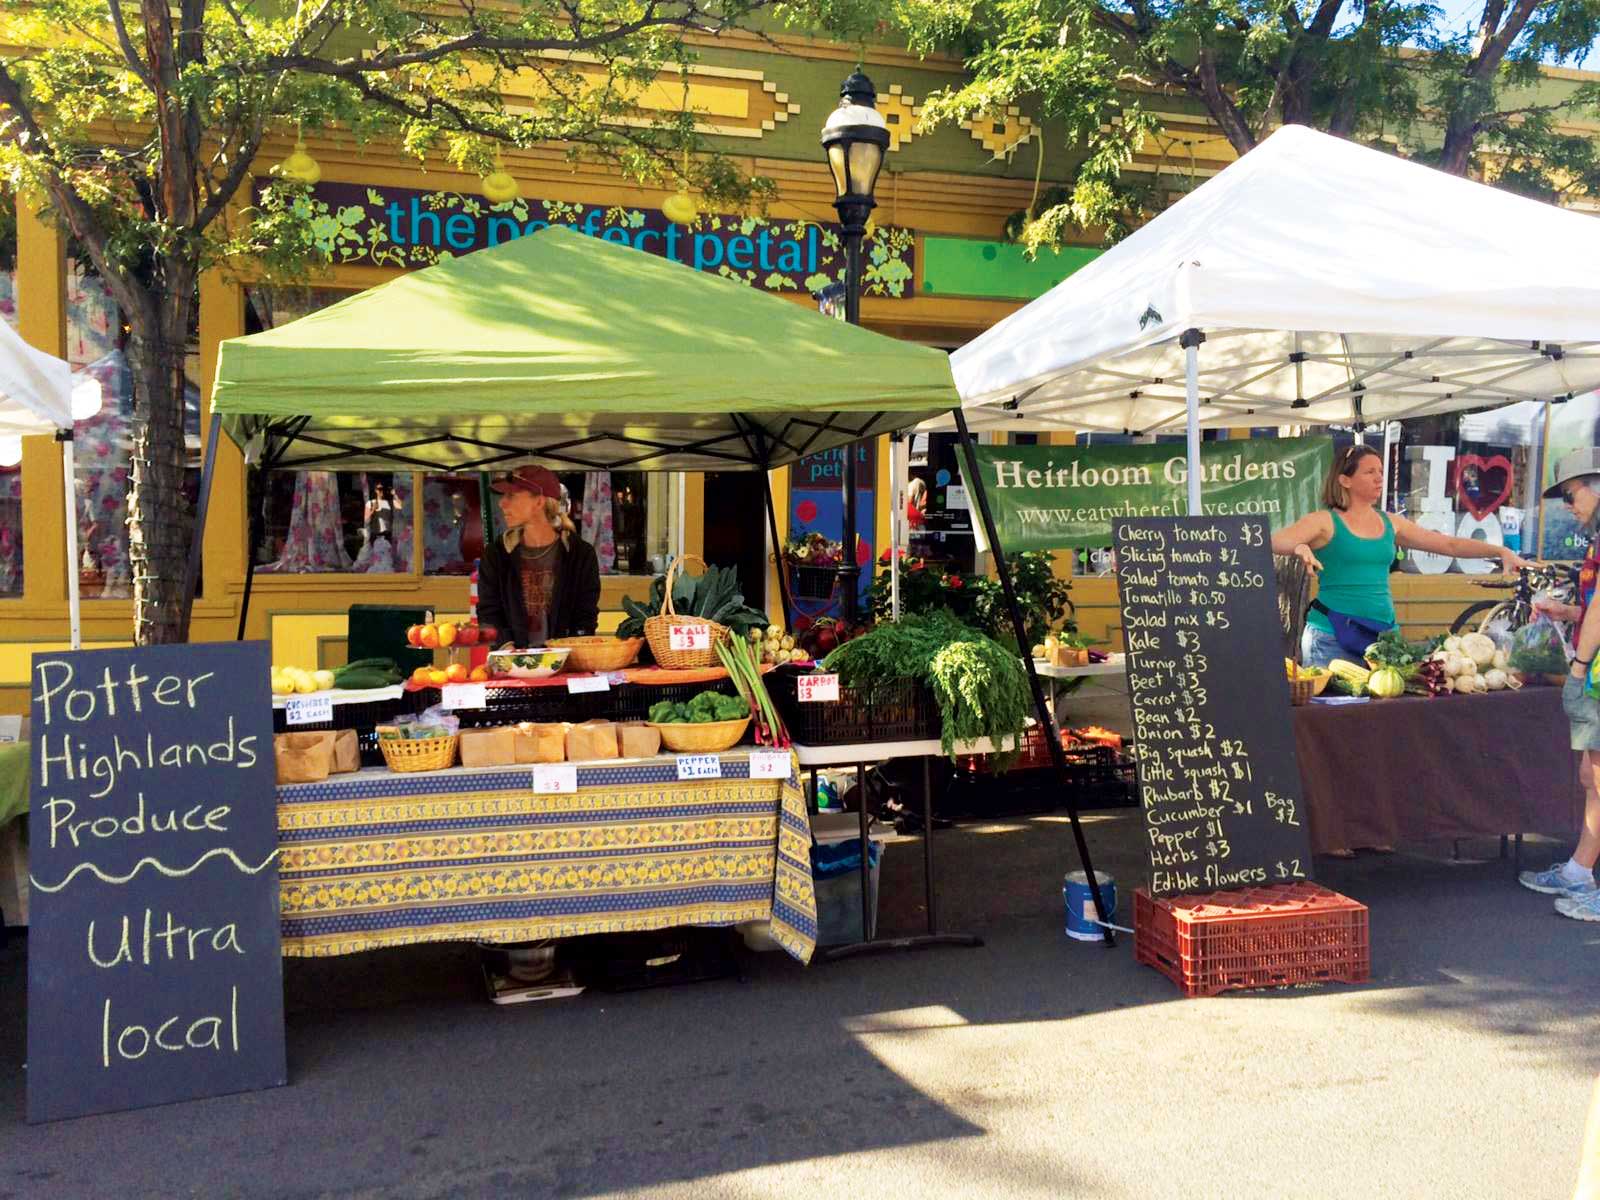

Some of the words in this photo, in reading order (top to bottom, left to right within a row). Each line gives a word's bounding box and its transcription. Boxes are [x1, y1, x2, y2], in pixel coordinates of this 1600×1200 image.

[385, 198, 476, 249] the
[694, 226, 817, 272] petal
[811, 461, 841, 482] pet
[993, 460, 1151, 488] Heirloom
[1119, 524, 1165, 550] Cherry
[1174, 524, 1227, 542] tomato
[1240, 522, 1263, 547] $3
[1120, 548, 1166, 572] Slicing
[1172, 549, 1212, 563] tomato
[1219, 548, 1240, 566] $2
[1120, 567, 1157, 587] Salad
[1167, 571, 1209, 586] tomato
[1216, 572, 1264, 588] $0.50
[1123, 588, 1182, 607] Tomatillo
[1189, 590, 1226, 605] $0.50
[1124, 607, 1166, 629] Salad
[1174, 614, 1199, 626] mix
[1206, 611, 1230, 629] $5
[674, 625, 706, 635] KALE
[1128, 631, 1160, 650] Kale
[1176, 630, 1200, 652] $3
[680, 636, 695, 648] $3
[1129, 651, 1176, 678] Turnip
[1183, 654, 1207, 672] $3
[34, 661, 214, 724] Potter
[799, 676, 836, 687] CARROT
[1129, 672, 1163, 691] Beet
[1176, 672, 1199, 689] $3
[800, 687, 812, 699] $3
[1133, 691, 1176, 706] Carrot
[1182, 688, 1207, 706] $3
[1134, 708, 1170, 724] Bean
[1174, 707, 1201, 723] $2
[1137, 724, 1183, 739] Onion
[1189, 723, 1216, 740] $2
[41, 716, 257, 797] Highlands
[678, 756, 717, 765] PEPPER
[1137, 743, 1160, 766] Big
[1168, 741, 1213, 768] squash
[1220, 739, 1248, 758] $2
[697, 767, 718, 775] EACH
[1141, 762, 1174, 782] Little
[1184, 761, 1228, 784] squash
[1231, 761, 1252, 782] $1
[1143, 784, 1204, 808] Rhubarb
[1209, 779, 1234, 803] $2
[1264, 791, 1295, 811] Bag
[42, 793, 231, 847] Produce
[1147, 802, 1225, 826] Cucumber
[1232, 801, 1252, 815] $1
[1275, 807, 1300, 826] $2
[1148, 825, 1200, 851] Pepper
[1205, 819, 1224, 838] $1
[1150, 849, 1198, 867] Herbs
[1205, 839, 1231, 858] $3
[1152, 871, 1199, 893] Edible
[1204, 862, 1267, 888] flowers
[1274, 859, 1306, 879] $2
[87, 908, 245, 968] Ultra
[103, 986, 238, 1067] local
